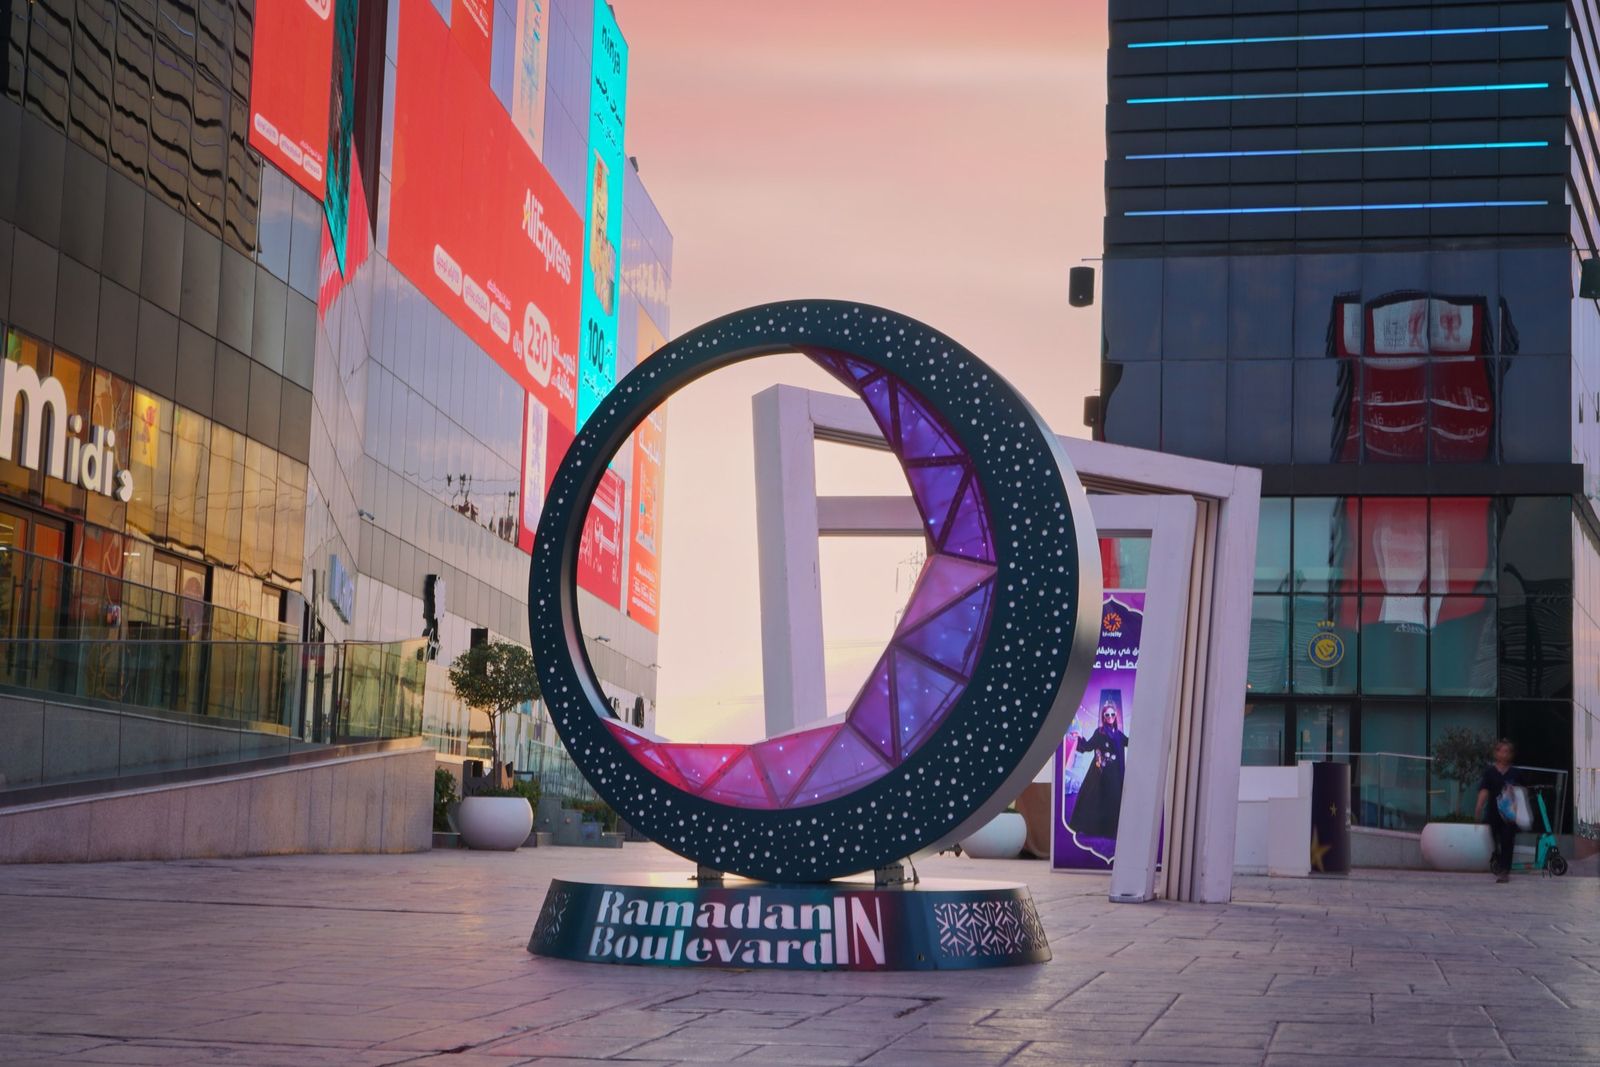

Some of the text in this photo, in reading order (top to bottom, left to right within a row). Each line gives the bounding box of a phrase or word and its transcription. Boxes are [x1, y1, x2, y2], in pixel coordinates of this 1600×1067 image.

[601, 24, 621, 74] ninja
[522, 188, 571, 285] AliExpress
[528, 316, 549, 371] 230
[588, 318, 605, 374] 100
[597, 890, 832, 930] Ramadan
[588, 926, 834, 965] Boulevard
